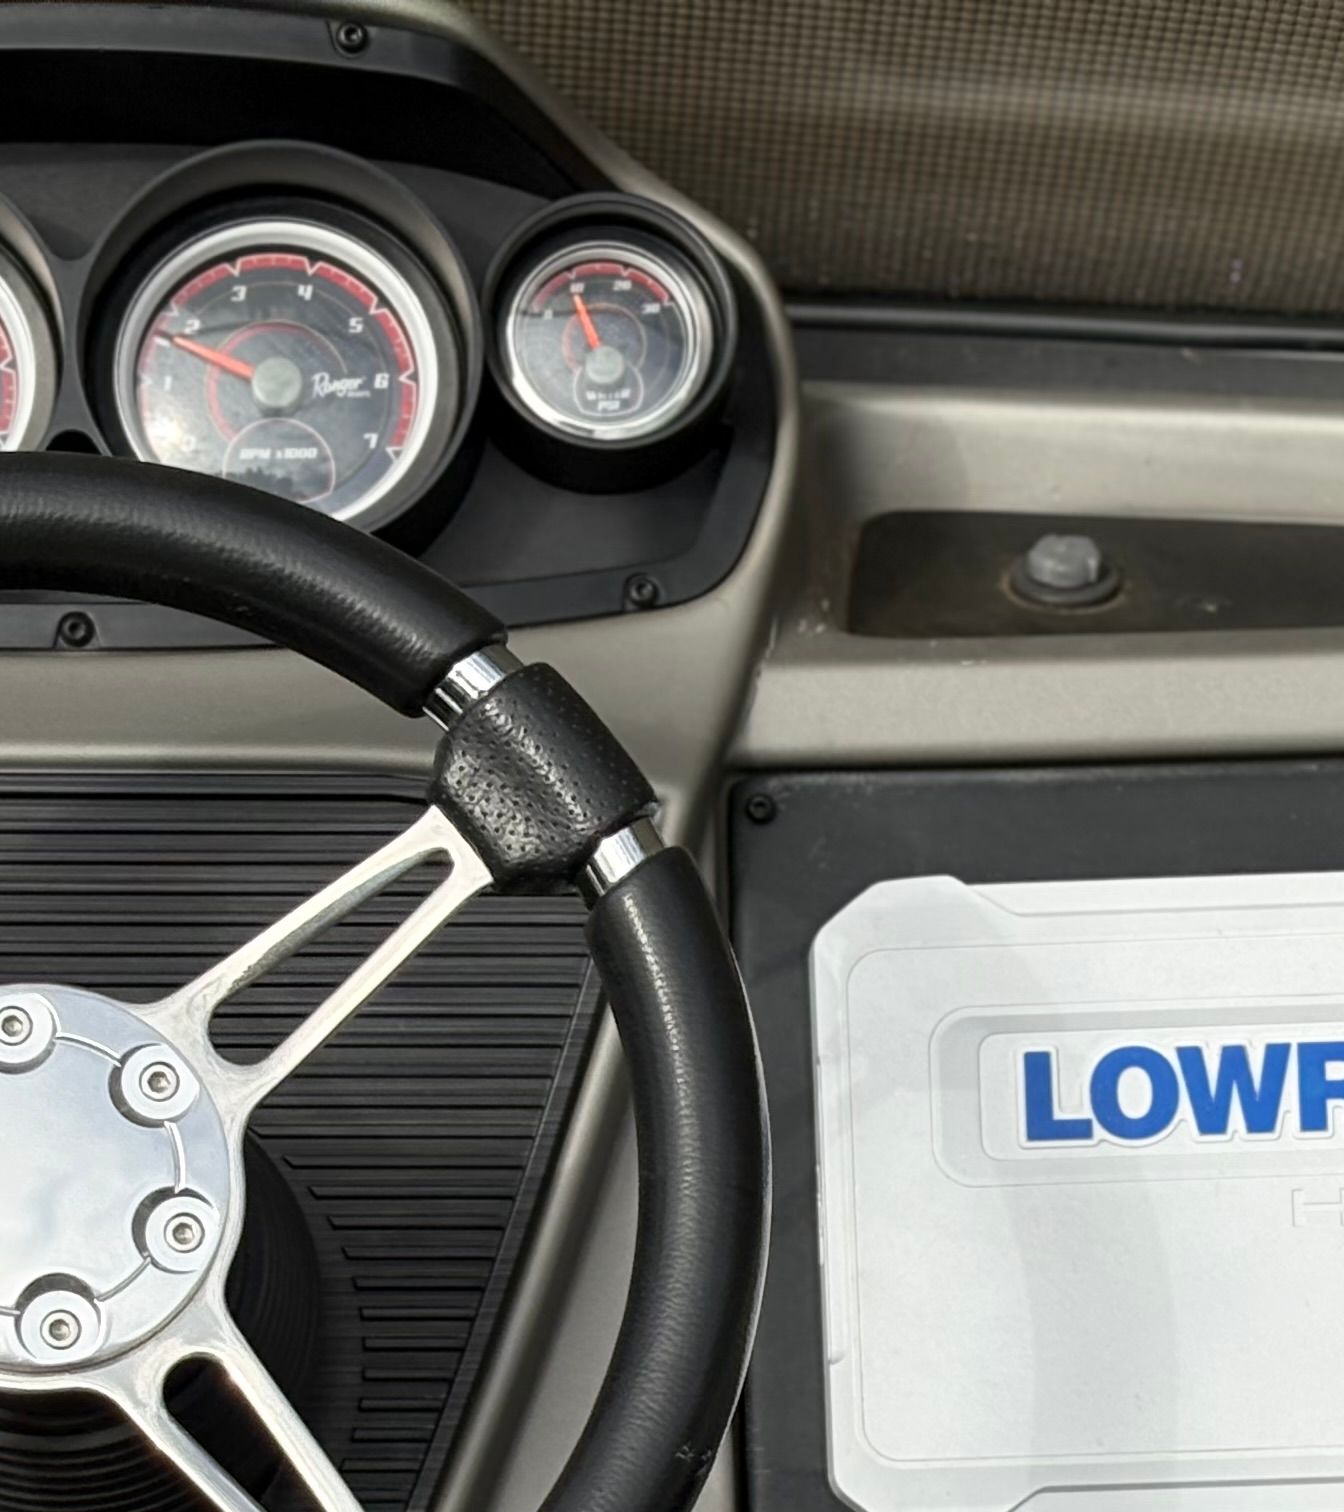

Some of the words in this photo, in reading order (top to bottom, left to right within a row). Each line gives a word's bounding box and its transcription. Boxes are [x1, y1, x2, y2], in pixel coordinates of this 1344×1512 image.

[231, 285, 247, 301] 3
[298, 284, 313, 300] 4
[184, 319, 200, 334] 2
[348, 317, 364, 333] 5
[163, 376, 172, 391] 1
[312, 371, 367, 398] Ranger
[374, 373, 389, 389] 6
[364, 433, 378, 448] 7
[240, 448, 269, 460] RPM
